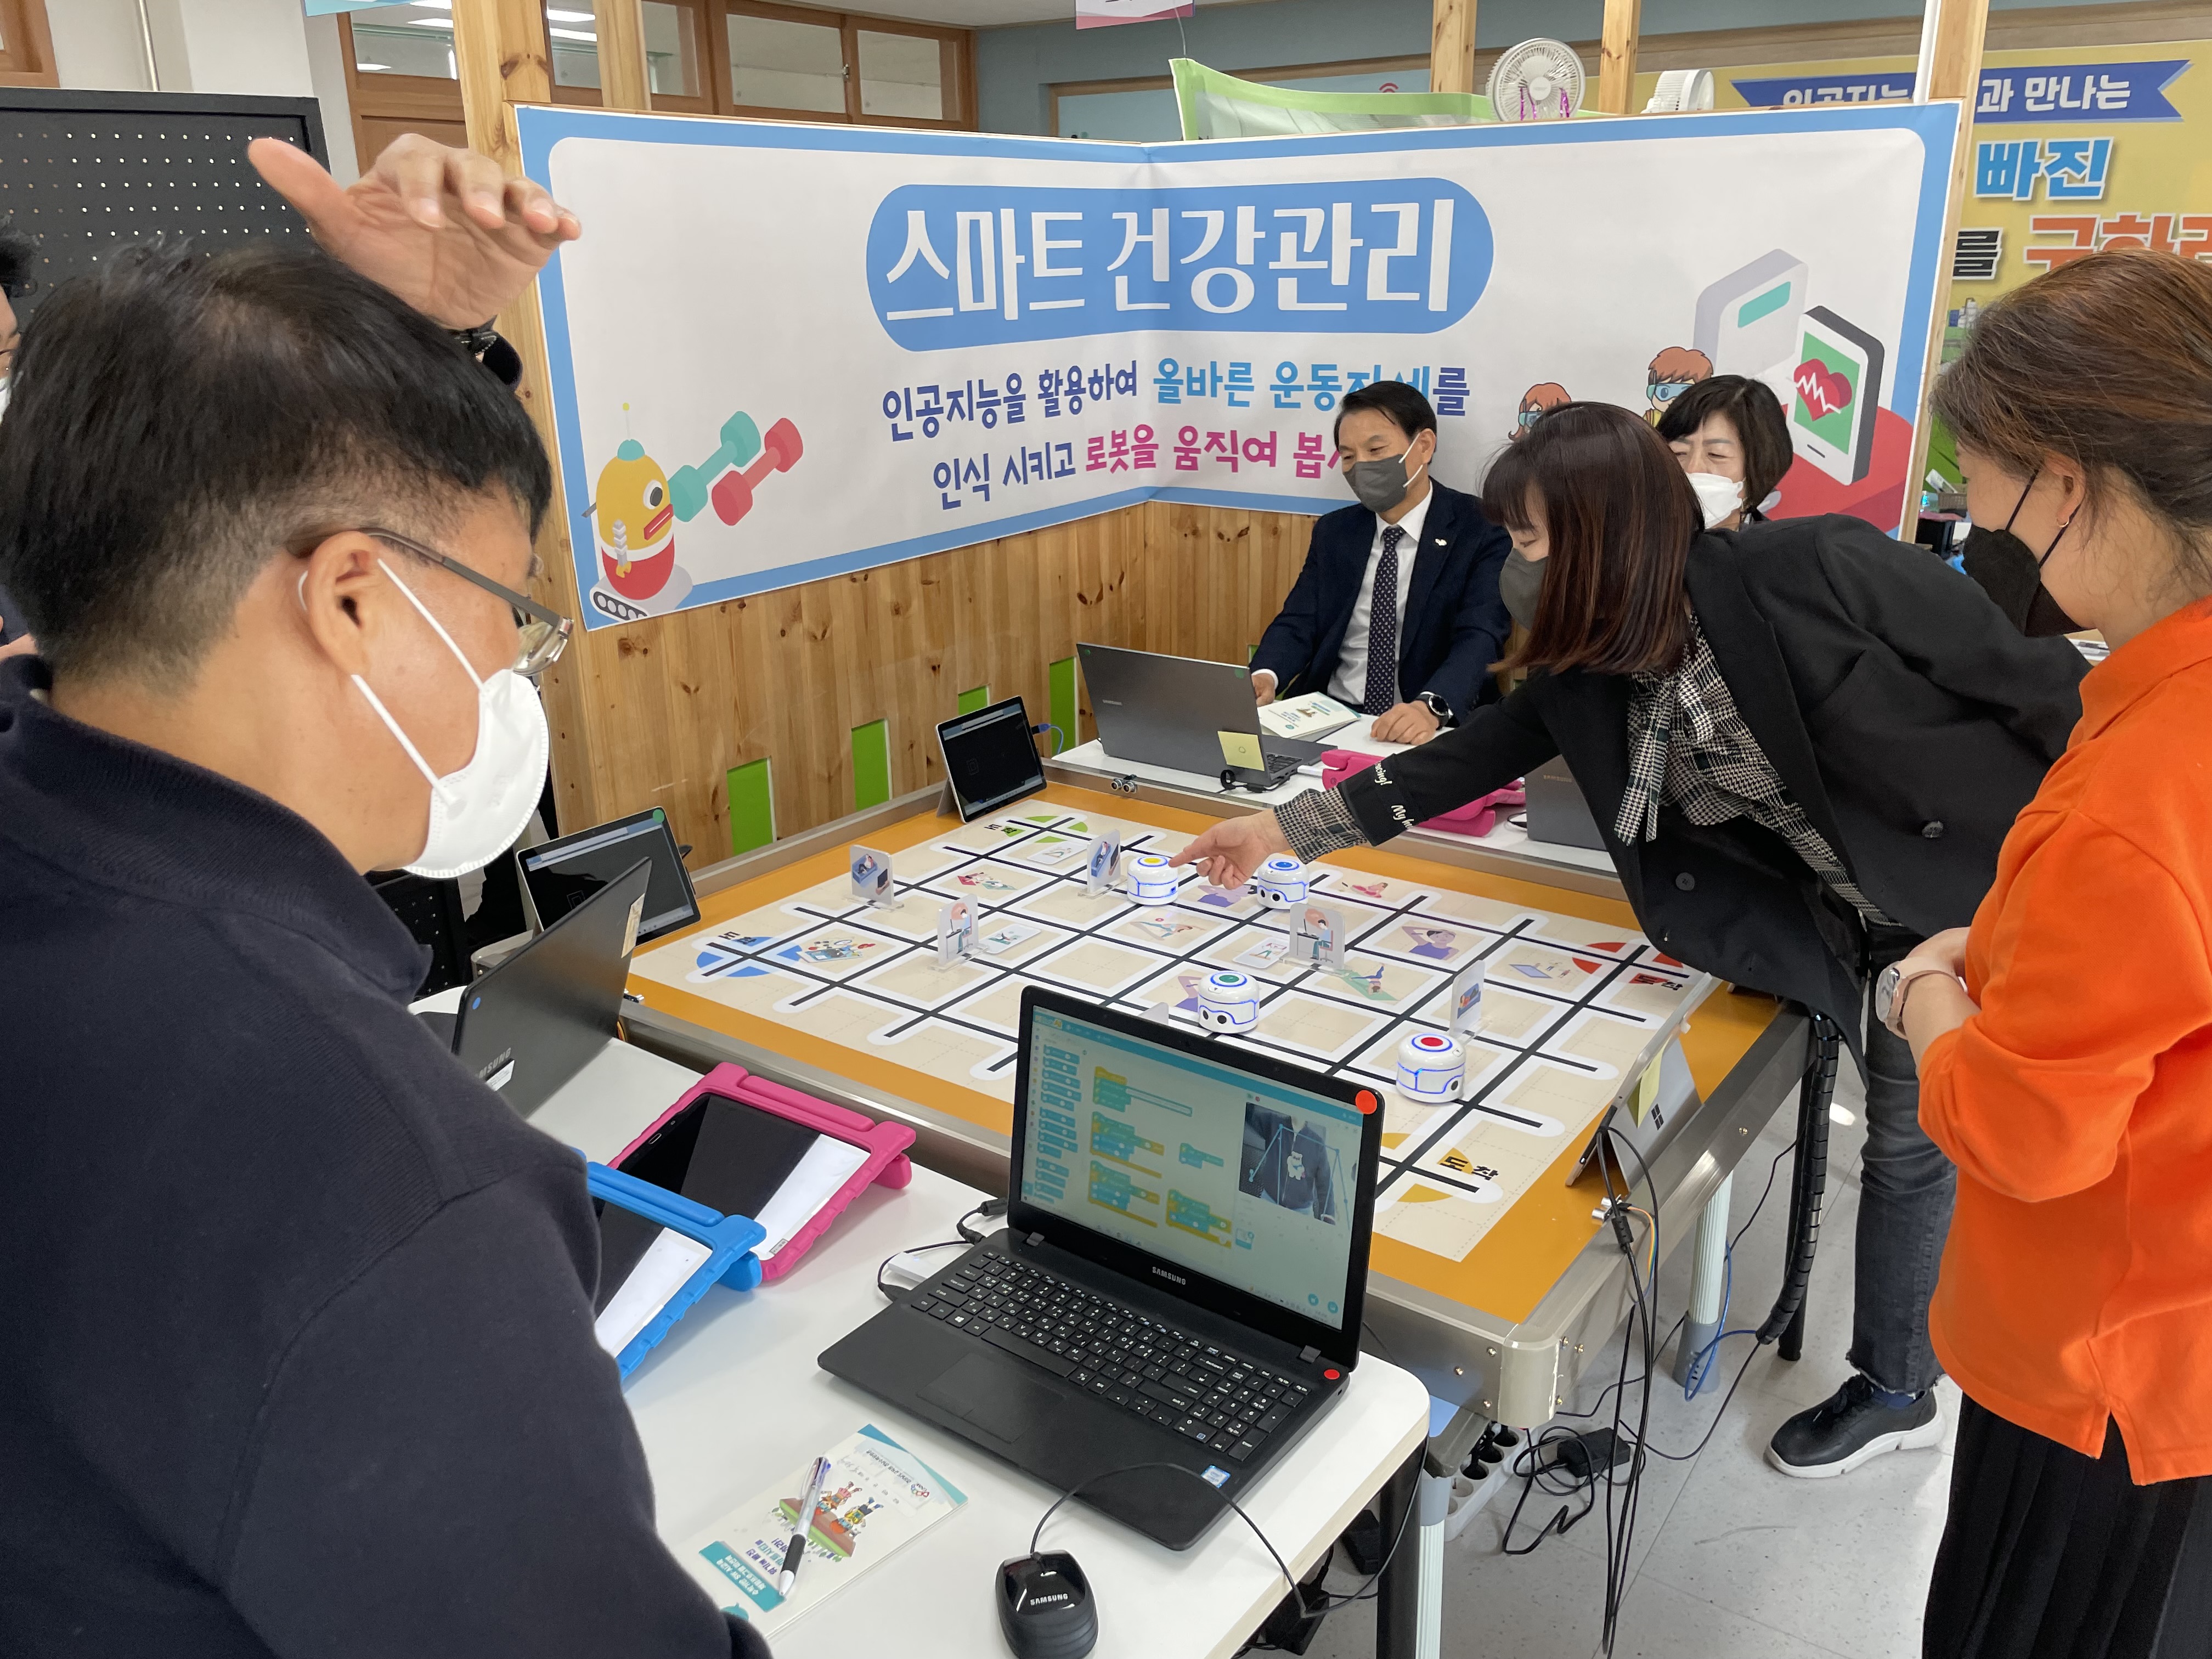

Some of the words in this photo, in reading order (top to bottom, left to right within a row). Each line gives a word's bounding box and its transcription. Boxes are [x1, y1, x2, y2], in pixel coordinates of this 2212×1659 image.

[2025, 75, 2130, 111] 만나는
[1974, 137, 2114, 201] 빠진
[887, 208, 1085, 320] 스마트
[1108, 199, 1454, 313] 건강관리
[883, 374, 1025, 441] 인공지능을
[1039, 360, 1136, 417] 활용하여
[1154, 358, 1254, 407] 올바른
[934, 454, 989, 509] 인식
[1003, 443, 1075, 484] 시키고
[1086, 424, 1159, 473] 로봇을
[1174, 426, 1277, 472] 움직여
[1391, 805, 1406, 820] My
[475, 1047, 511, 1079] MSUNG
[1439, 1155, 1499, 1181] 도착
[1152, 1266, 1186, 1285] SAMSUNG
[753, 1539, 787, 1566] 마트시티를
[770, 1537, 791, 1553] 하라!
[1030, 1593, 1068, 1606] SAMSUNG
